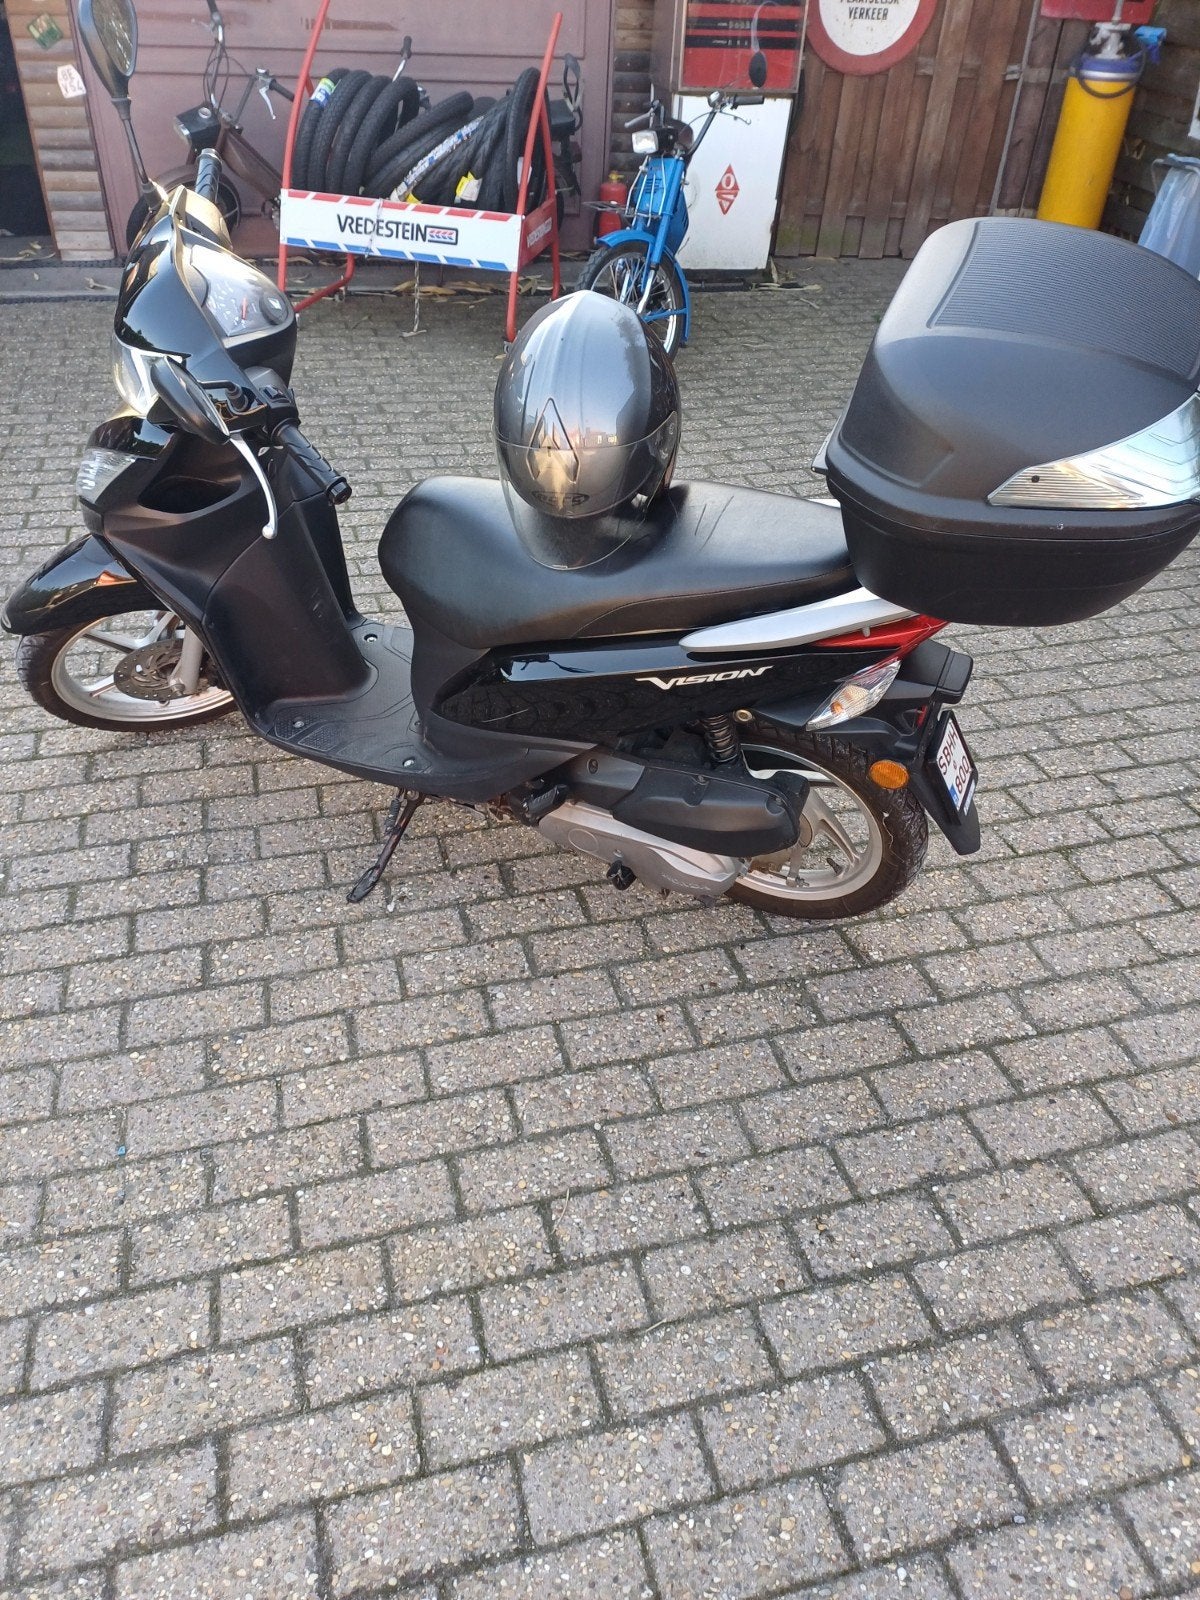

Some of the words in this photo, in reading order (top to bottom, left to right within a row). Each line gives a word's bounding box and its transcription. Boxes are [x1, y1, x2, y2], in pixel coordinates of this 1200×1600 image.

[848, 6, 889, 20] VERKEER
[336, 213, 427, 243] VREDESTEIN
[635, 665, 774, 690] VISION
[955, 755, 970, 794] 800
